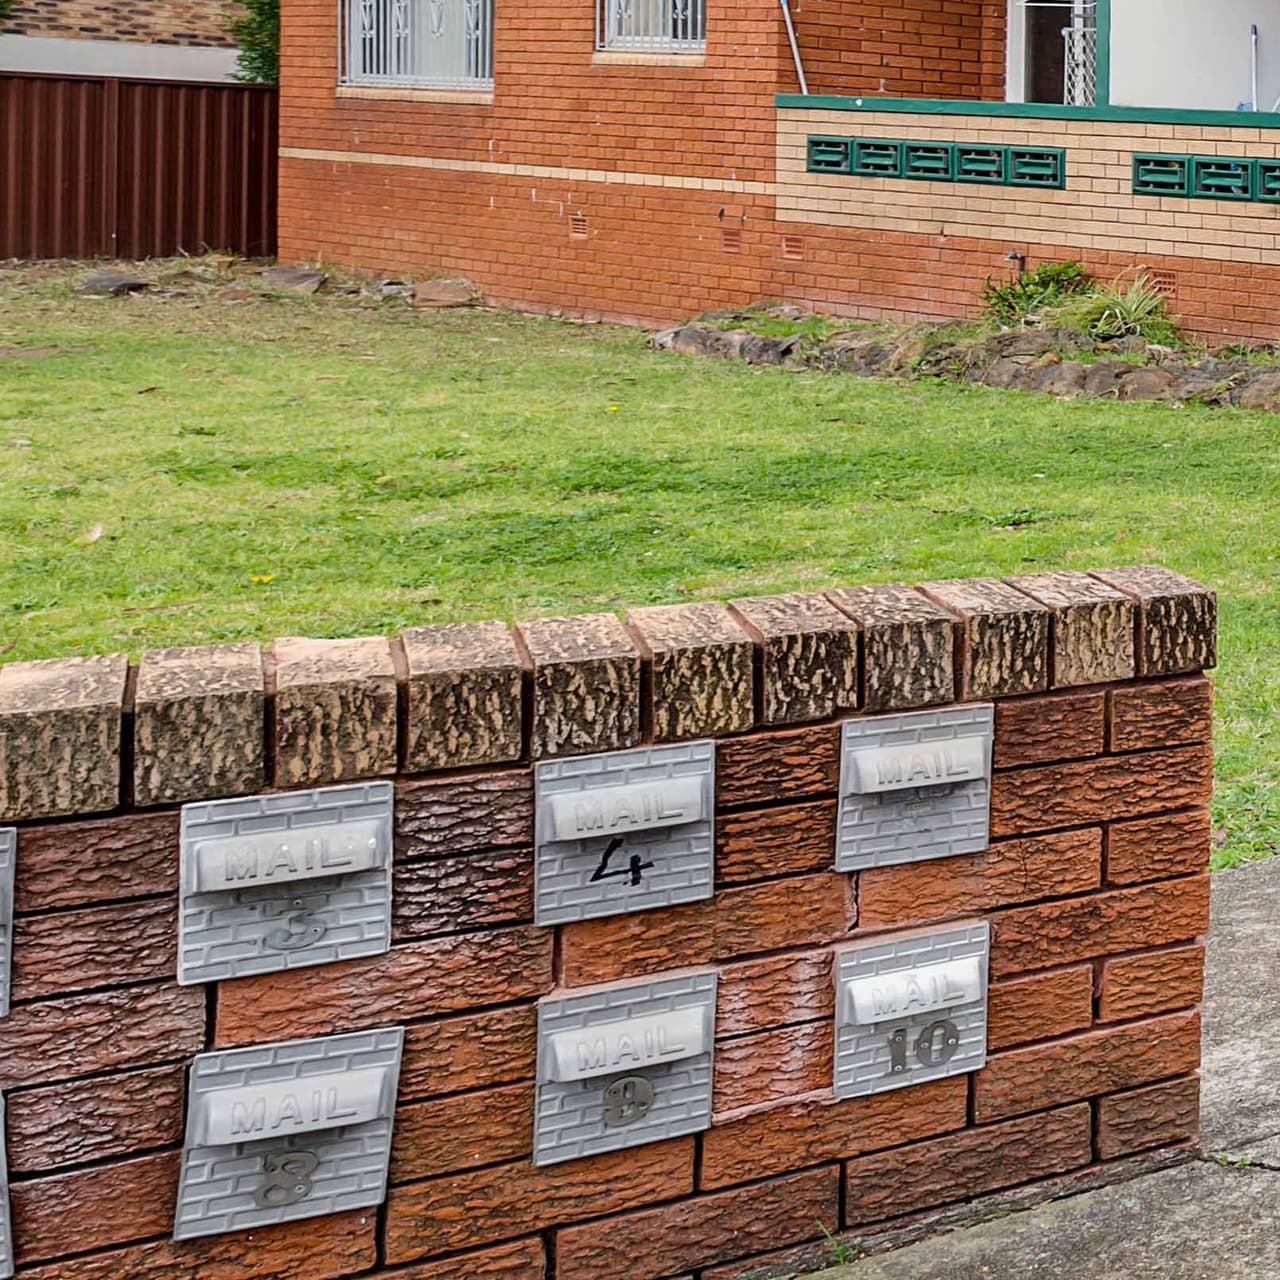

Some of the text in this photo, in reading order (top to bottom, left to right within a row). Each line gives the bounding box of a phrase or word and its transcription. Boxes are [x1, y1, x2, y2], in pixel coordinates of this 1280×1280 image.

[876, 751, 969, 785] MAIL
[575, 790, 683, 831] MAIL
[224, 837, 353, 881] MAIL
[589, 838, 654, 885] 4
[871, 974, 965, 1017] MAIL
[577, 1027, 686, 1071] MAIL
[889, 1019, 960, 1074] 10
[230, 1087, 358, 1135] MAIL
[601, 1076, 655, 1127] 9
[254, 1151, 319, 1207] 8
